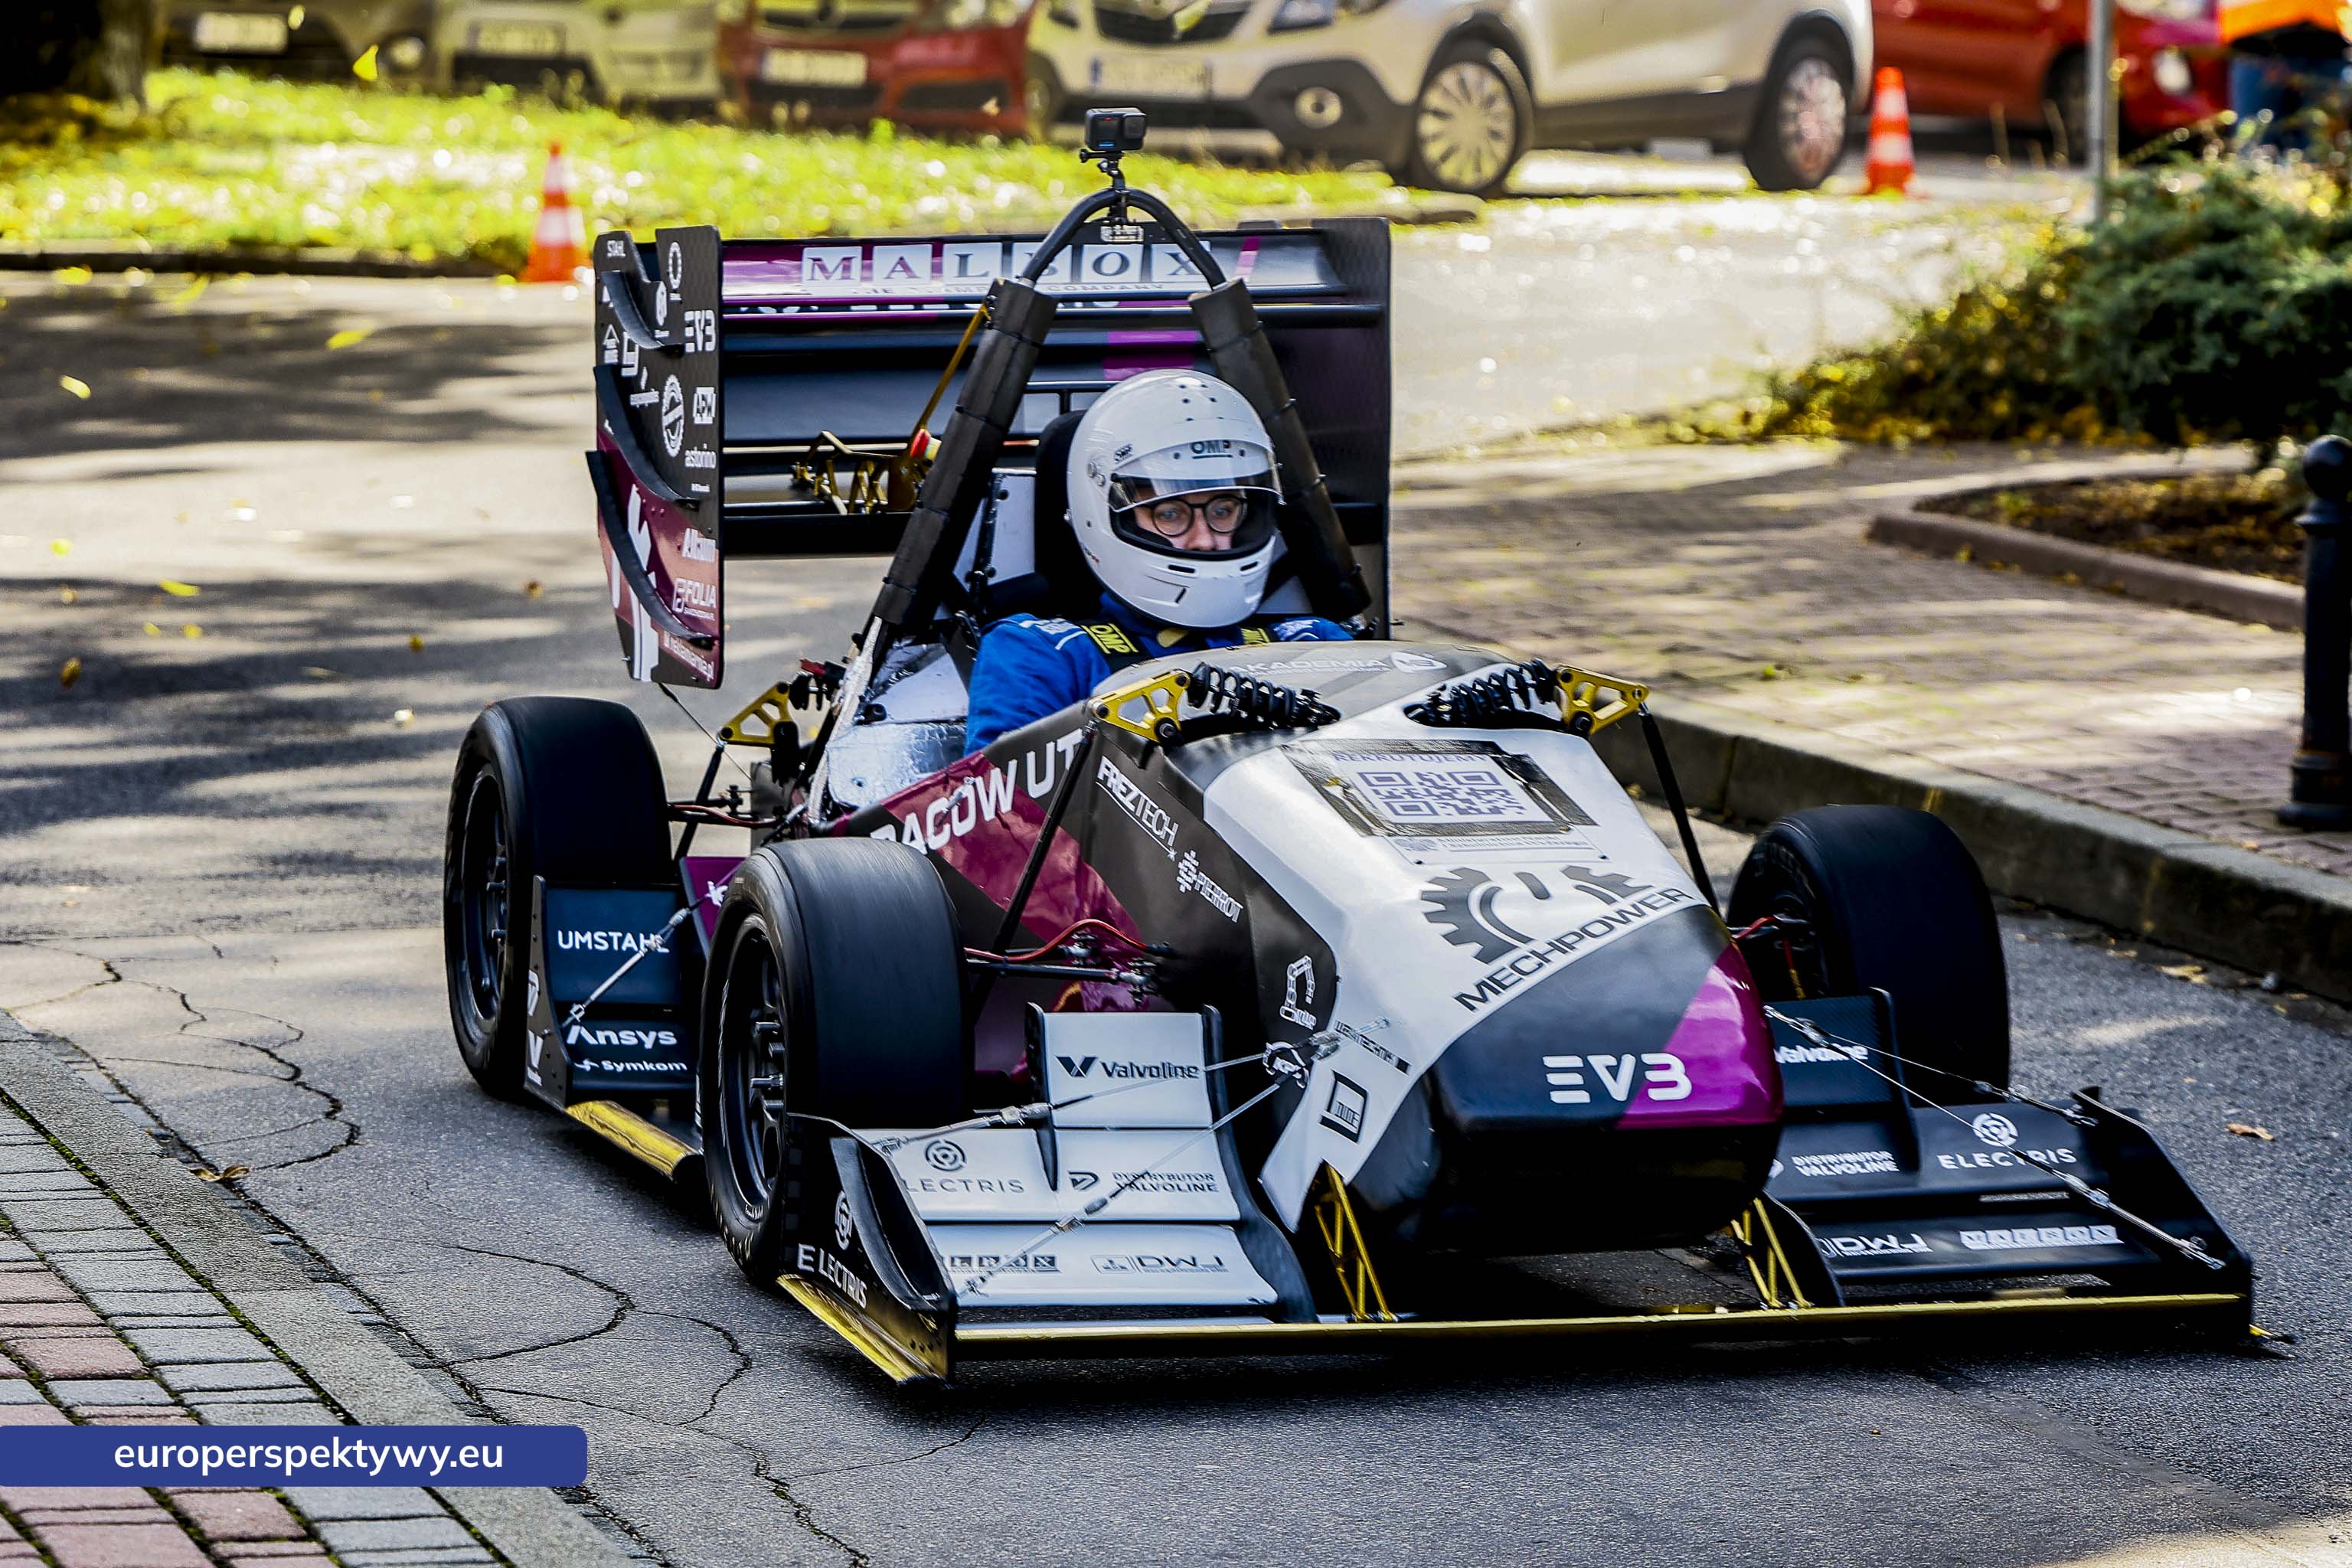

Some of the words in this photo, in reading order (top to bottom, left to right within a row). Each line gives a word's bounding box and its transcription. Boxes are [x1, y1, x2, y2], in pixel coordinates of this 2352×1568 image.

[1089, 624, 1131, 654] OMP
[1453, 887, 1695, 1011] MECHPOWER
[567, 1025, 678, 1049] Ansys
[1100, 1061, 1200, 1079] Valvoline
[1792, 1151, 1895, 1166] DISTRIBUTOR
[1795, 1161, 1900, 1177] VALVOLINE
[1937, 1148, 2077, 1169] ELECTRIS
[797, 1243, 867, 1310] ELECTRIS
